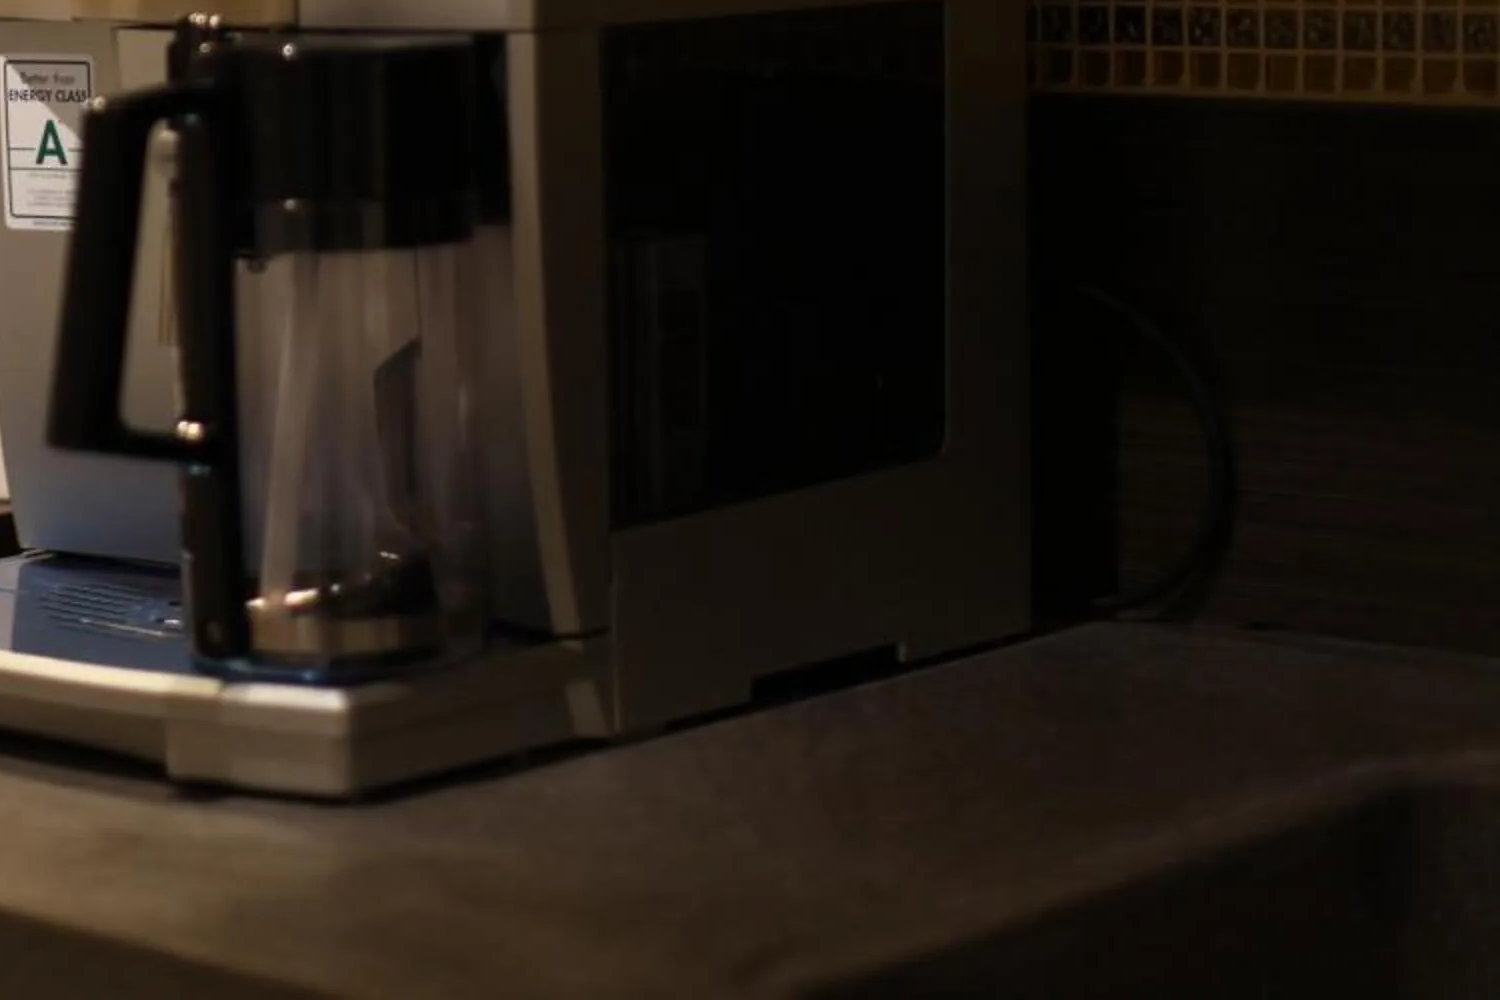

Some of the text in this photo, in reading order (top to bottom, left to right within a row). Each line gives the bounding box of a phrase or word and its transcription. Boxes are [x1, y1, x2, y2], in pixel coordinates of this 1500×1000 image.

[8, 88, 87, 103] ENERGY CLASS
[35, 119, 68, 165] A
